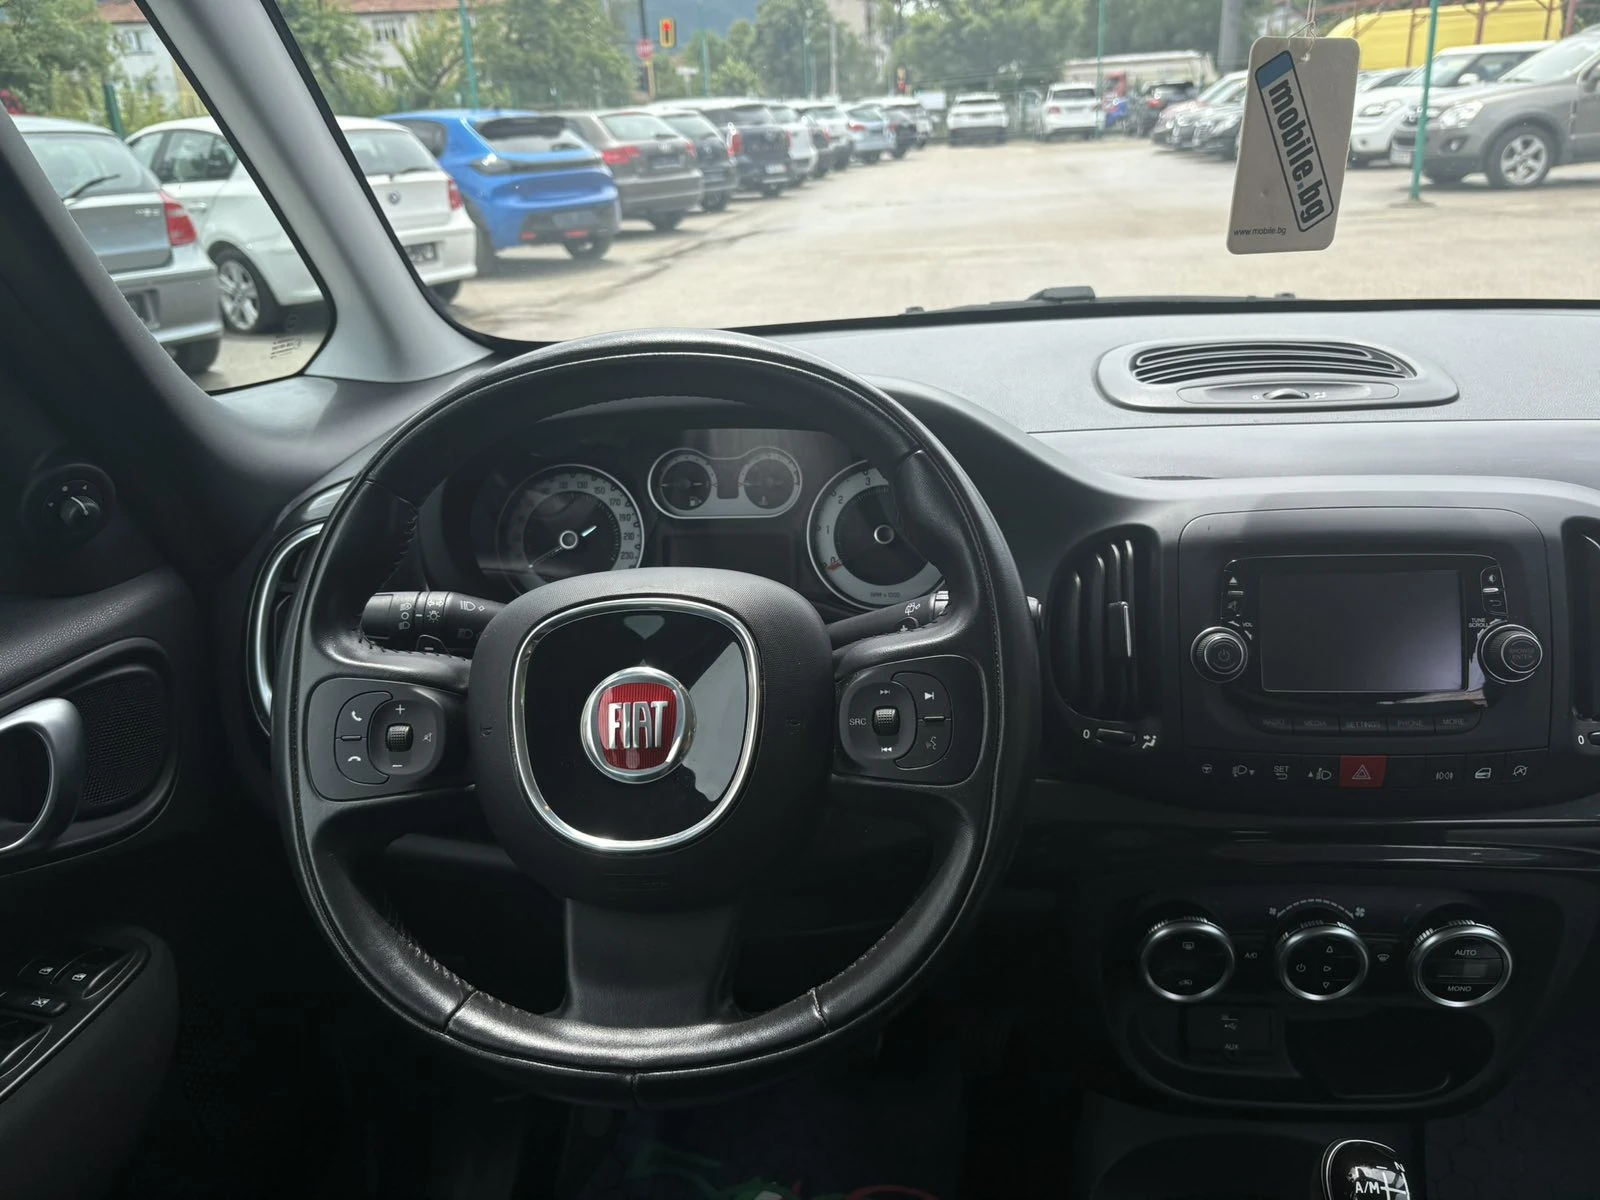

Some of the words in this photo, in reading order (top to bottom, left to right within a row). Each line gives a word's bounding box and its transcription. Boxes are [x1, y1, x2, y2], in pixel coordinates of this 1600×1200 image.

[1268, 79, 1325, 224] mobile.bg
[1233, 226, 1287, 236] www.mobile.bg
[865, 477, 871, 486] 3
[594, 487, 605, 495] 150
[610, 498, 621, 506] 170
[838, 495, 844, 504] 2
[619, 513, 631, 521] 190
[621, 552, 633, 560] 230
[608, 701, 669, 749] FIAT
[849, 717, 867, 726] SRC
[1303, 720, 1328, 728] MEDIA
[1397, 719, 1424, 728] PHONE
[1442, 717, 1465, 726] MORE
[1273, 765, 1290, 773] SET
[1393, 1161, 1406, 1172] N
[1355, 1181, 1380, 1194] A/M
